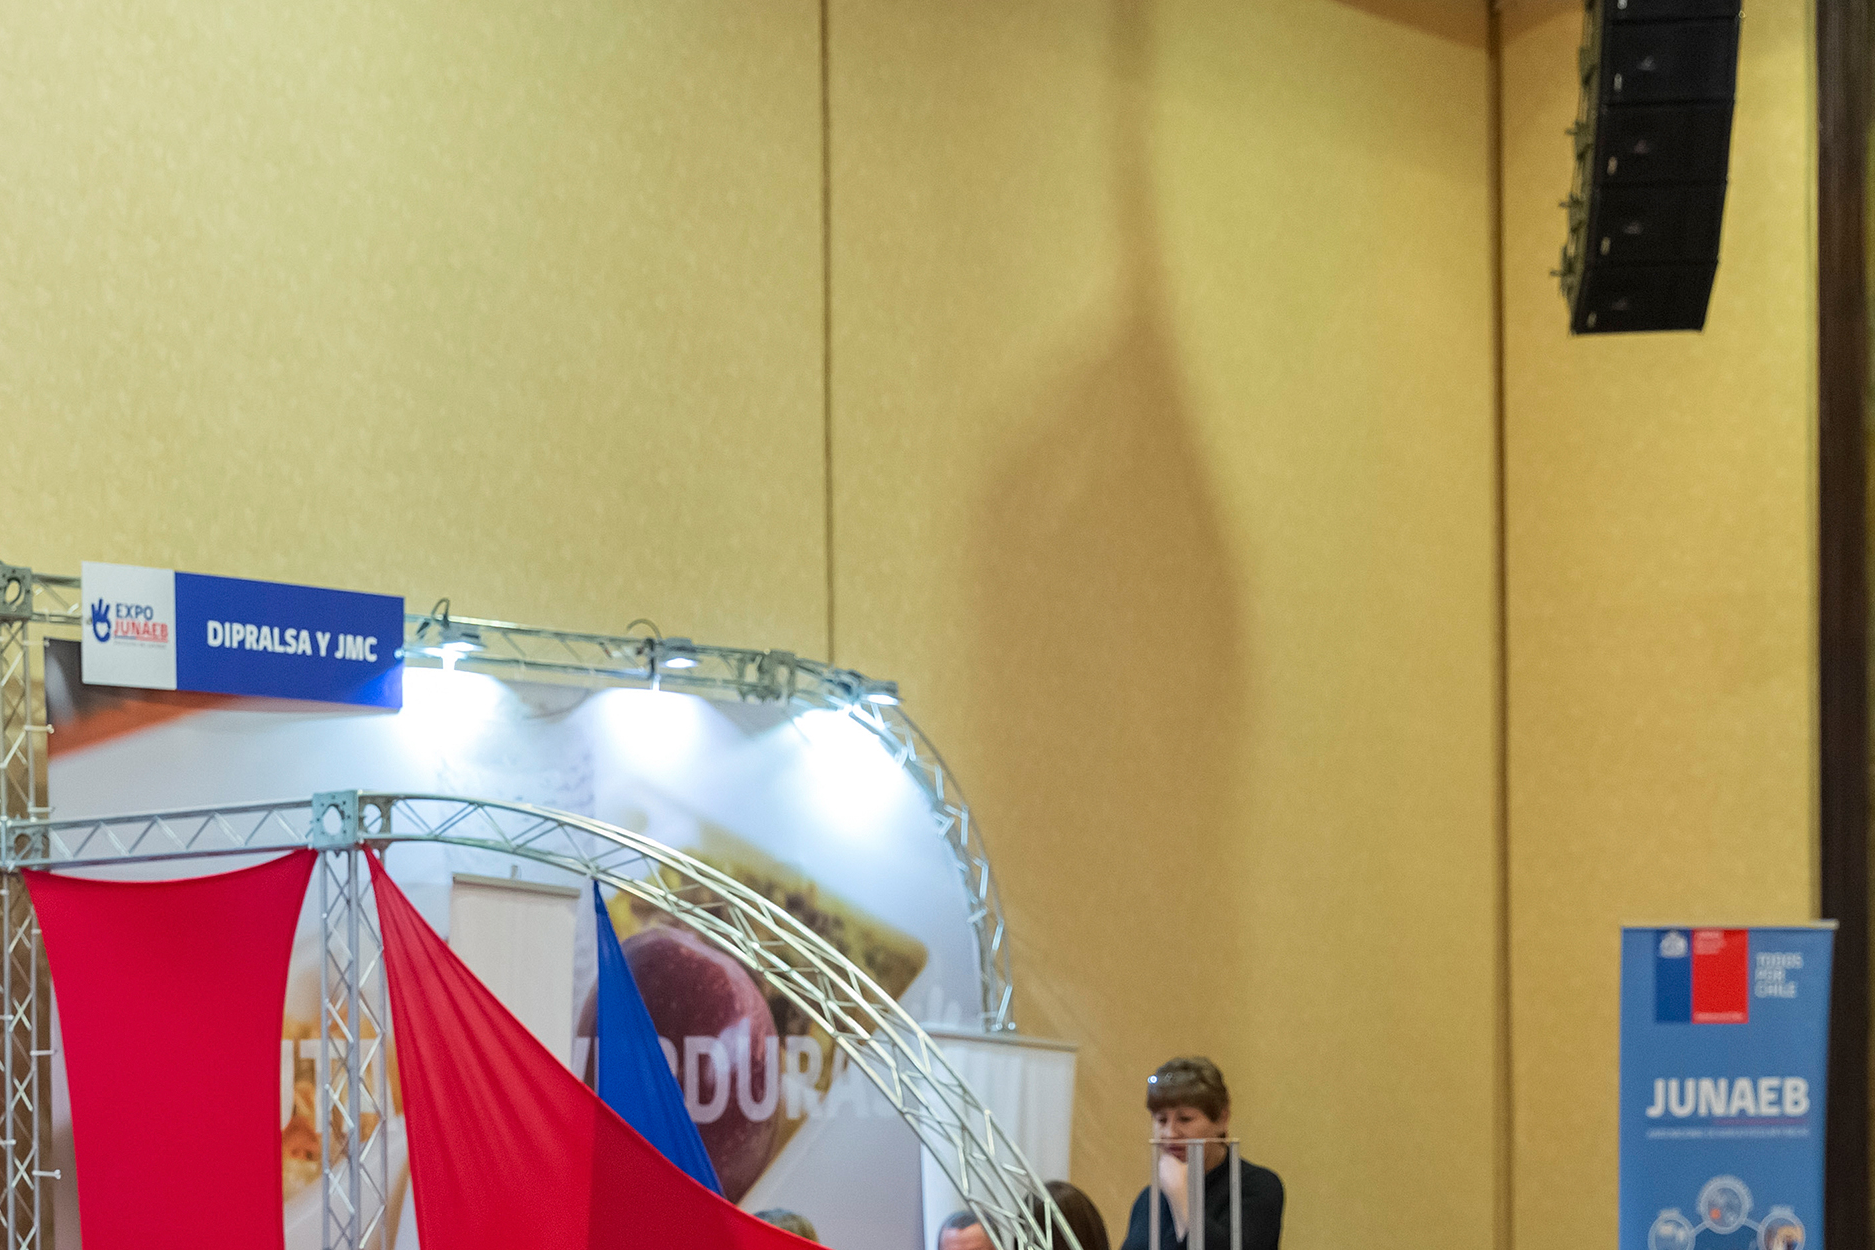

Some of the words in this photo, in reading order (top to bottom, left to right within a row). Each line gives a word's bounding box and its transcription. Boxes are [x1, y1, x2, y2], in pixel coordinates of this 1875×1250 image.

[115, 603, 154, 621] EXPO
[113, 619, 169, 640] JUNAEB
[206, 620, 313, 657] DIPRALSA
[315, 631, 331, 657] Y
[334, 633, 378, 663] JMC
[1645, 1075, 1810, 1118] JUNAEB
